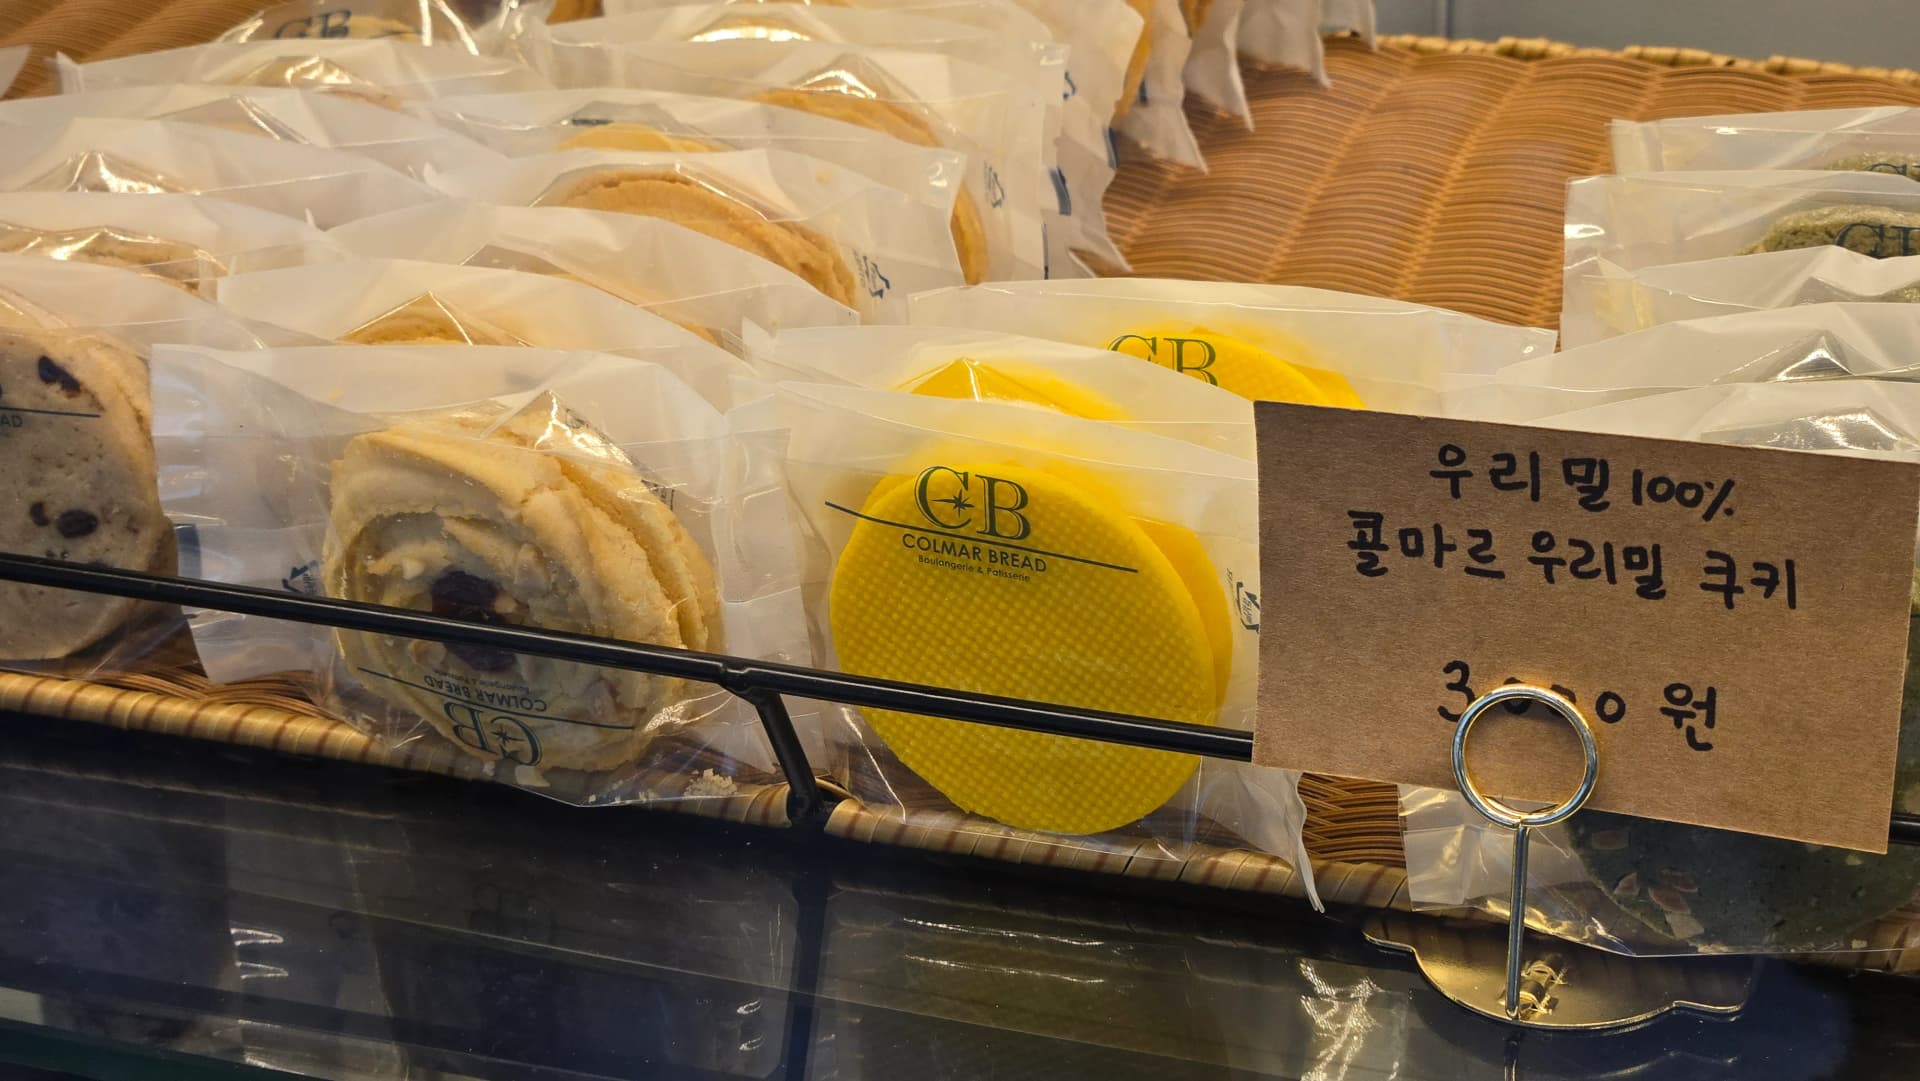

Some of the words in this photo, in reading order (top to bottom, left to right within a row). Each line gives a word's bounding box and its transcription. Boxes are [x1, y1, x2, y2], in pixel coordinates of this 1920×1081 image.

[913, 465, 1032, 541] CB
[1429, 443, 1611, 513] 우리밀
[1631, 468, 1736, 522] 100%
[902, 532, 983, 562] COLMAR
[987, 549, 1048, 573] BREAD
[918, 554, 975, 573] Boulangerie
[977, 565, 984, 574] &
[986, 567, 1031, 583] Patisserie
[1346, 509, 1506, 578] 콜마르
[1527, 530, 1667, 600] 우리밀
[1699, 549, 1797, 610] 쿠키
[423, 674, 472, 699] BREAD
[475, 687, 548, 713] COLMAR
[1659, 682, 1718, 752] 원
